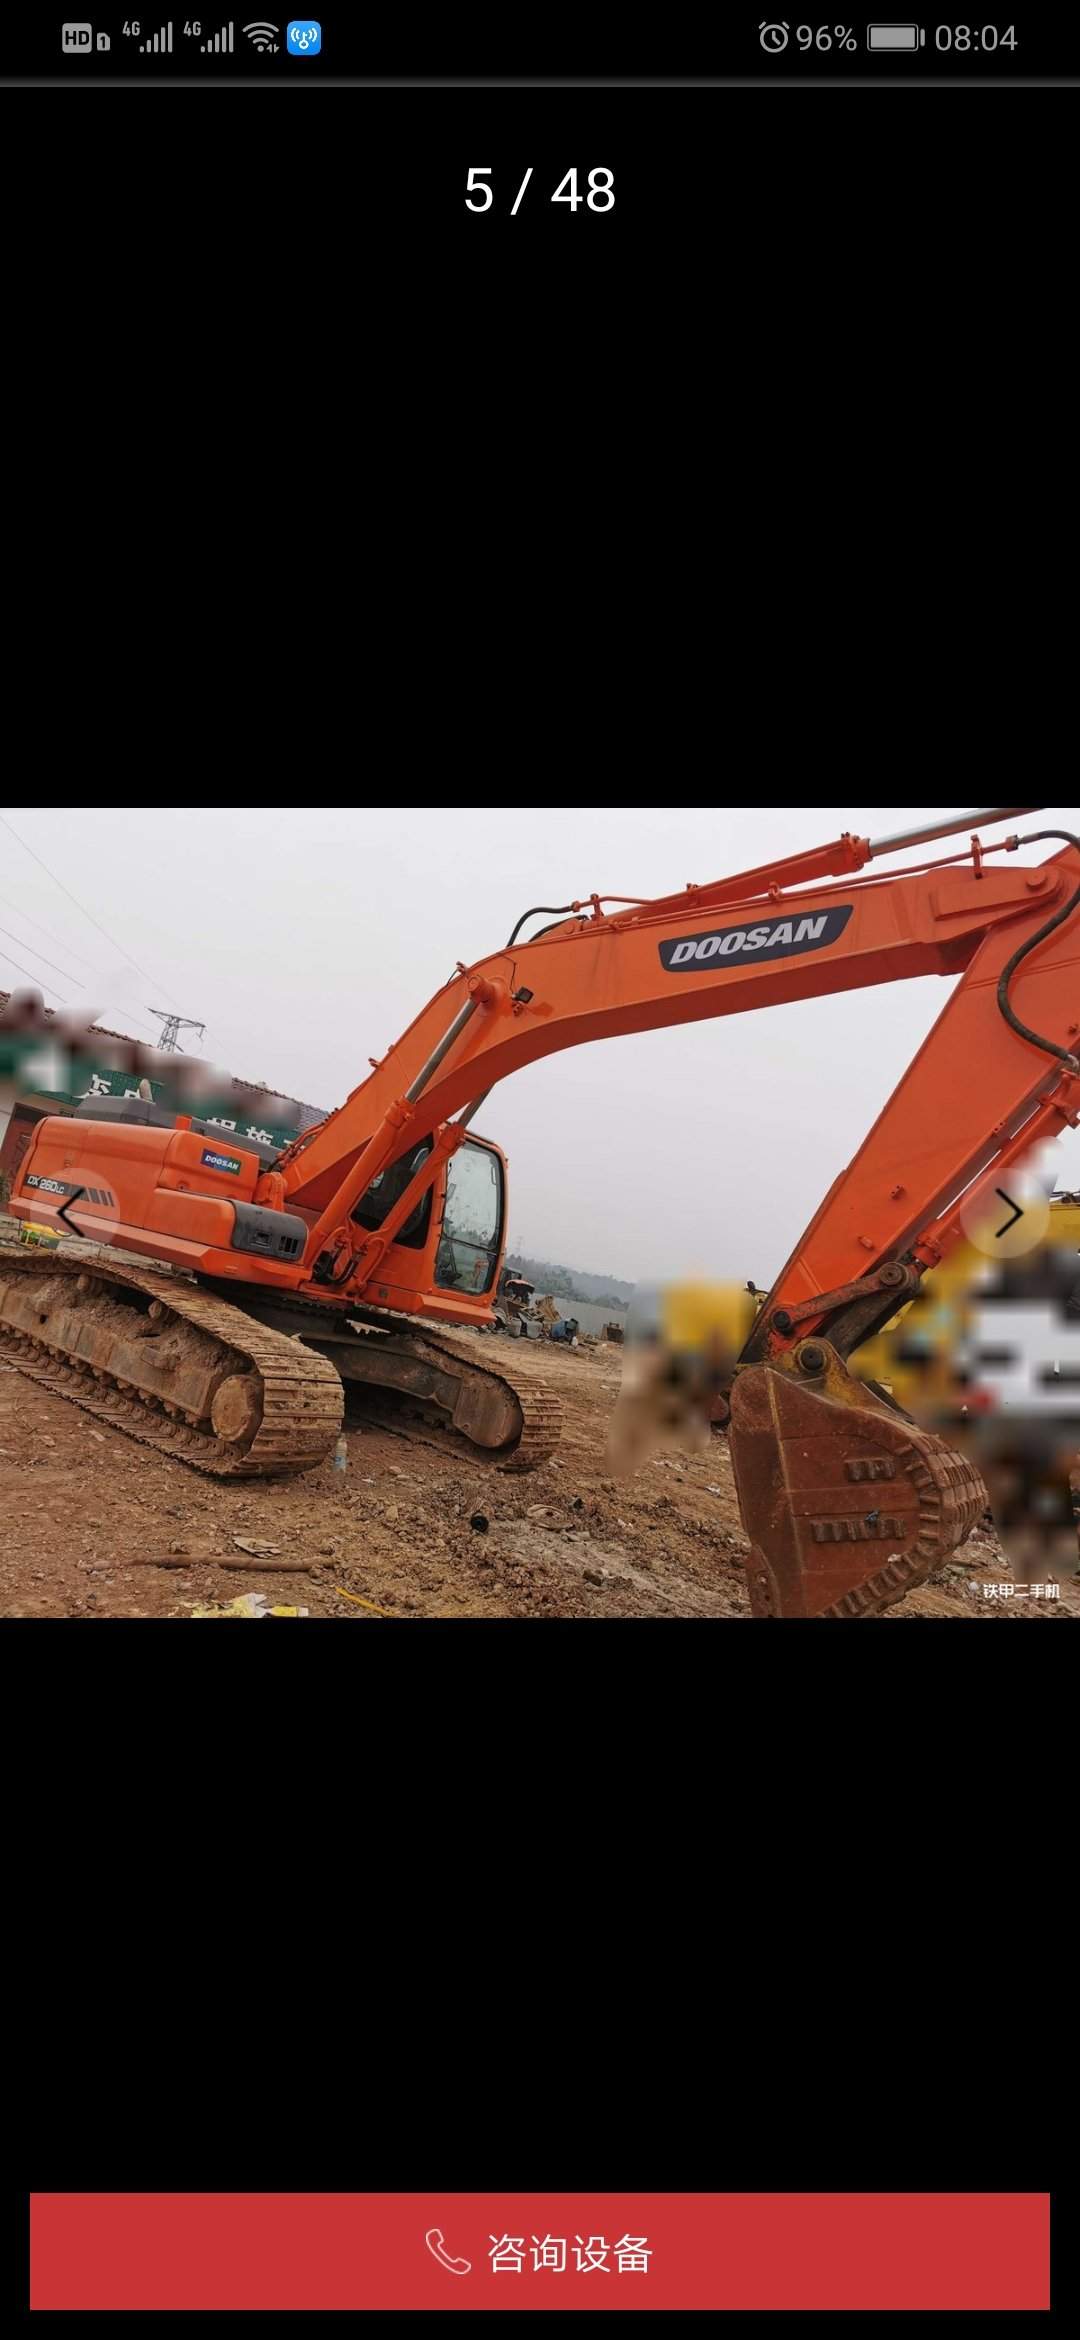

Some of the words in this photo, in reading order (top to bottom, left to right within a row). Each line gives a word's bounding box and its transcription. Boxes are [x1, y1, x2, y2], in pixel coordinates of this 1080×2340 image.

[64, 30, 90, 46] HD
[122, 21, 140, 36] 4G
[183, 21, 201, 36] 4G
[797, 25, 858, 51] 96%
[935, 25, 1018, 51] 08:04
[464, 167, 494, 213] 5
[510, 167, 534, 216] /
[550, 166, 616, 213] 48
[669, 915, 829, 965] DOOSAN
[204, 1154, 240, 1170] DOOSAN
[27, 1175, 41, 1187] DX
[488, 2233, 653, 2274] 咨询设备
